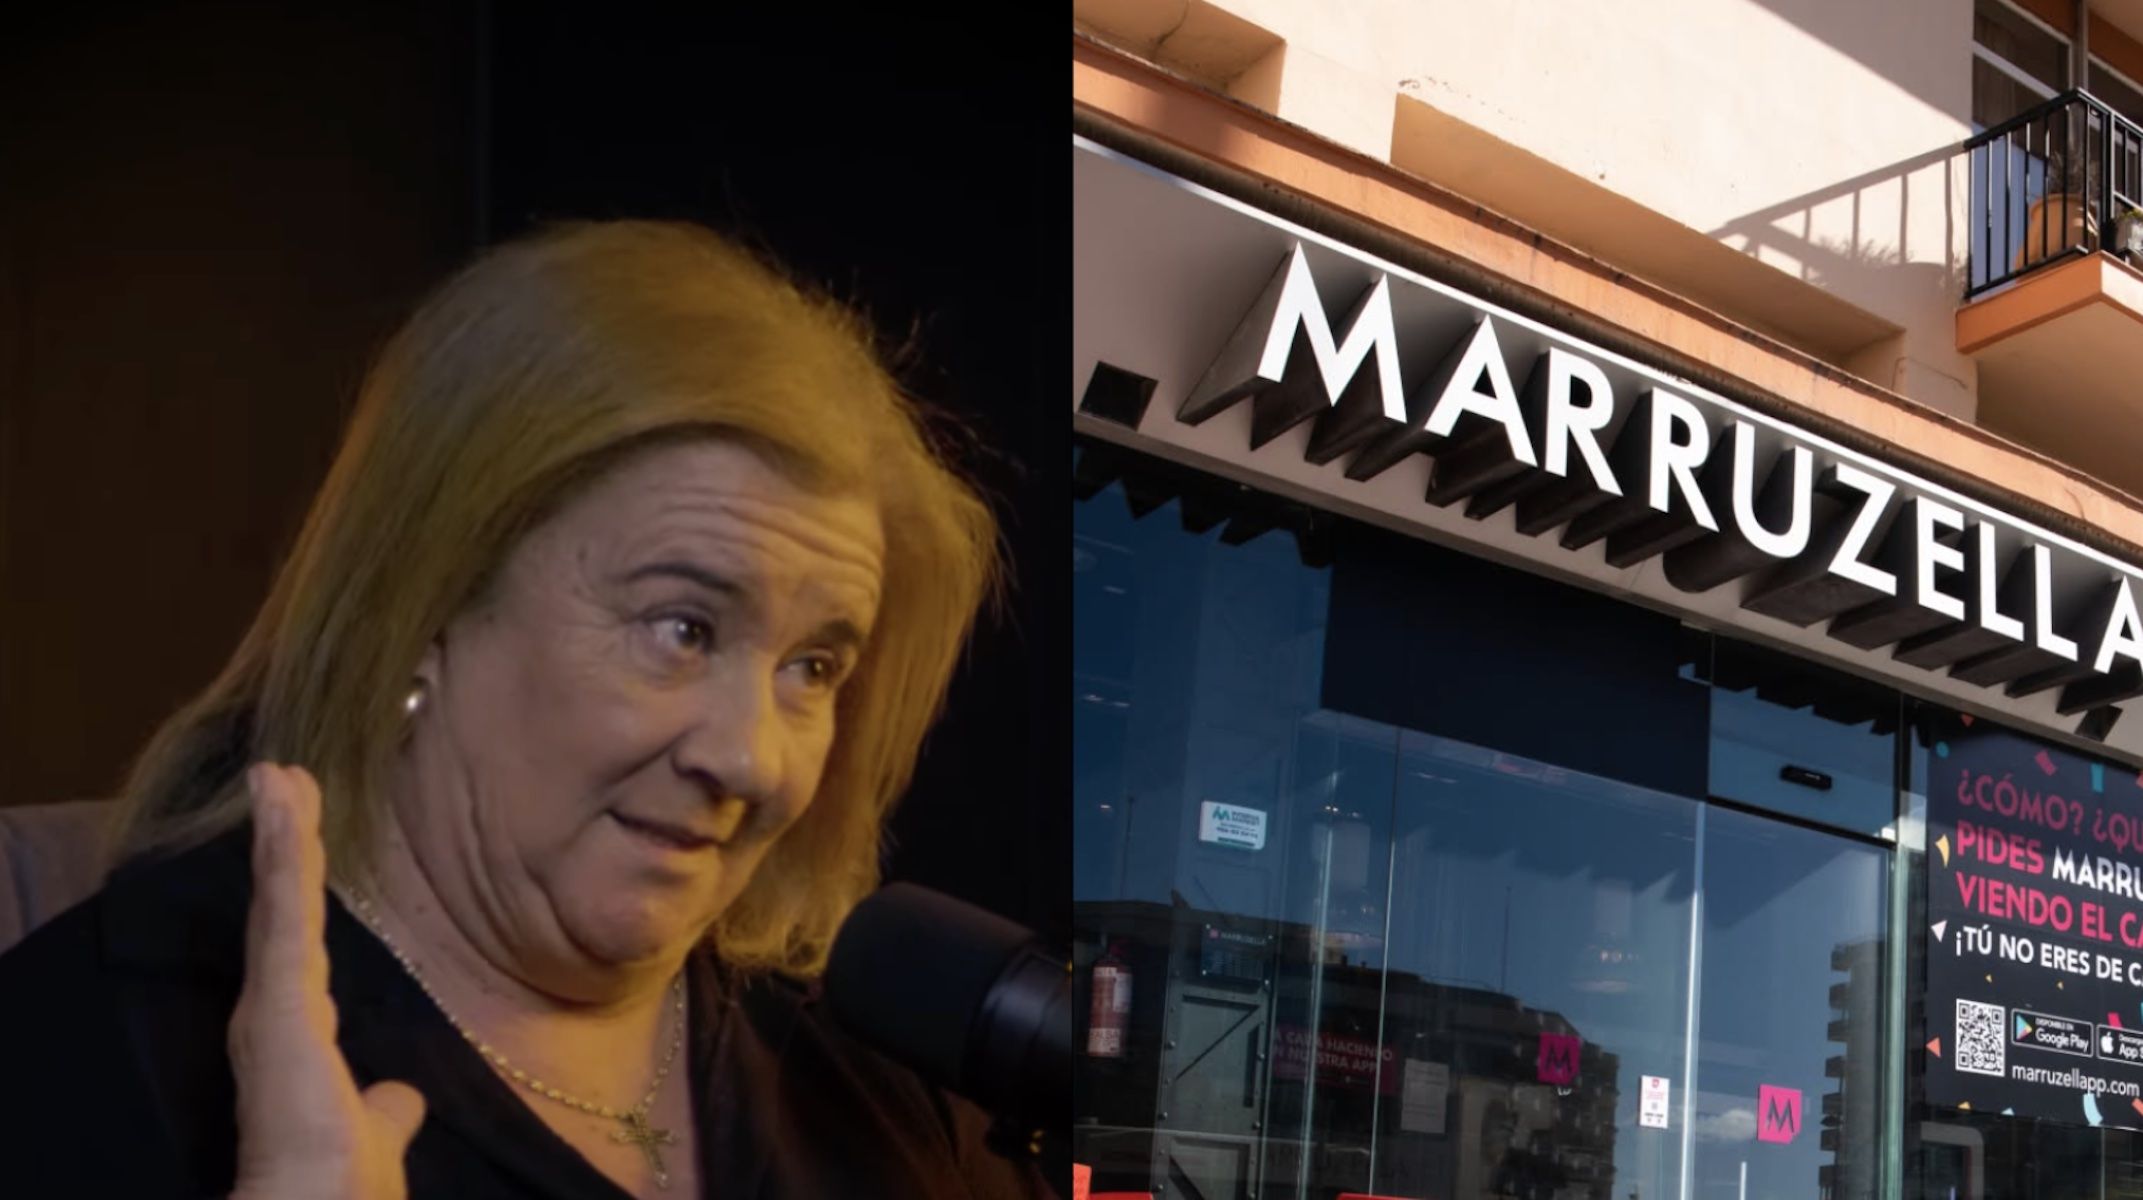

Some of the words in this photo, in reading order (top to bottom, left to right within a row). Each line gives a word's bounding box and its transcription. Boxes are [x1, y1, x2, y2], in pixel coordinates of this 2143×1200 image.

[1258, 241, 2143, 677] MARRUZELLA
[1957, 769, 2084, 836] ¿CÓMO?
[1956, 820, 2045, 875] PIDES
[1956, 871, 2073, 932] VIENDO
[2081, 901, 2113, 941] EL
[1956, 924, 1992, 956] ¡TÚ
[1999, 934, 2034, 963] NO
[2040, 942, 2090, 976] ERES
[2096, 954, 2123, 982] DE
[1288, 1045, 1349, 1069] NUSTRA
[1544, 1043, 1573, 1073] M
[2035, 1027, 2069, 1049] Google
[2070, 1033, 2089, 1053] Play
[2119, 1042, 2139, 1059] App
[2012, 1065, 2140, 1098] marruzellapp.com
[1765, 1095, 1795, 1134] M
